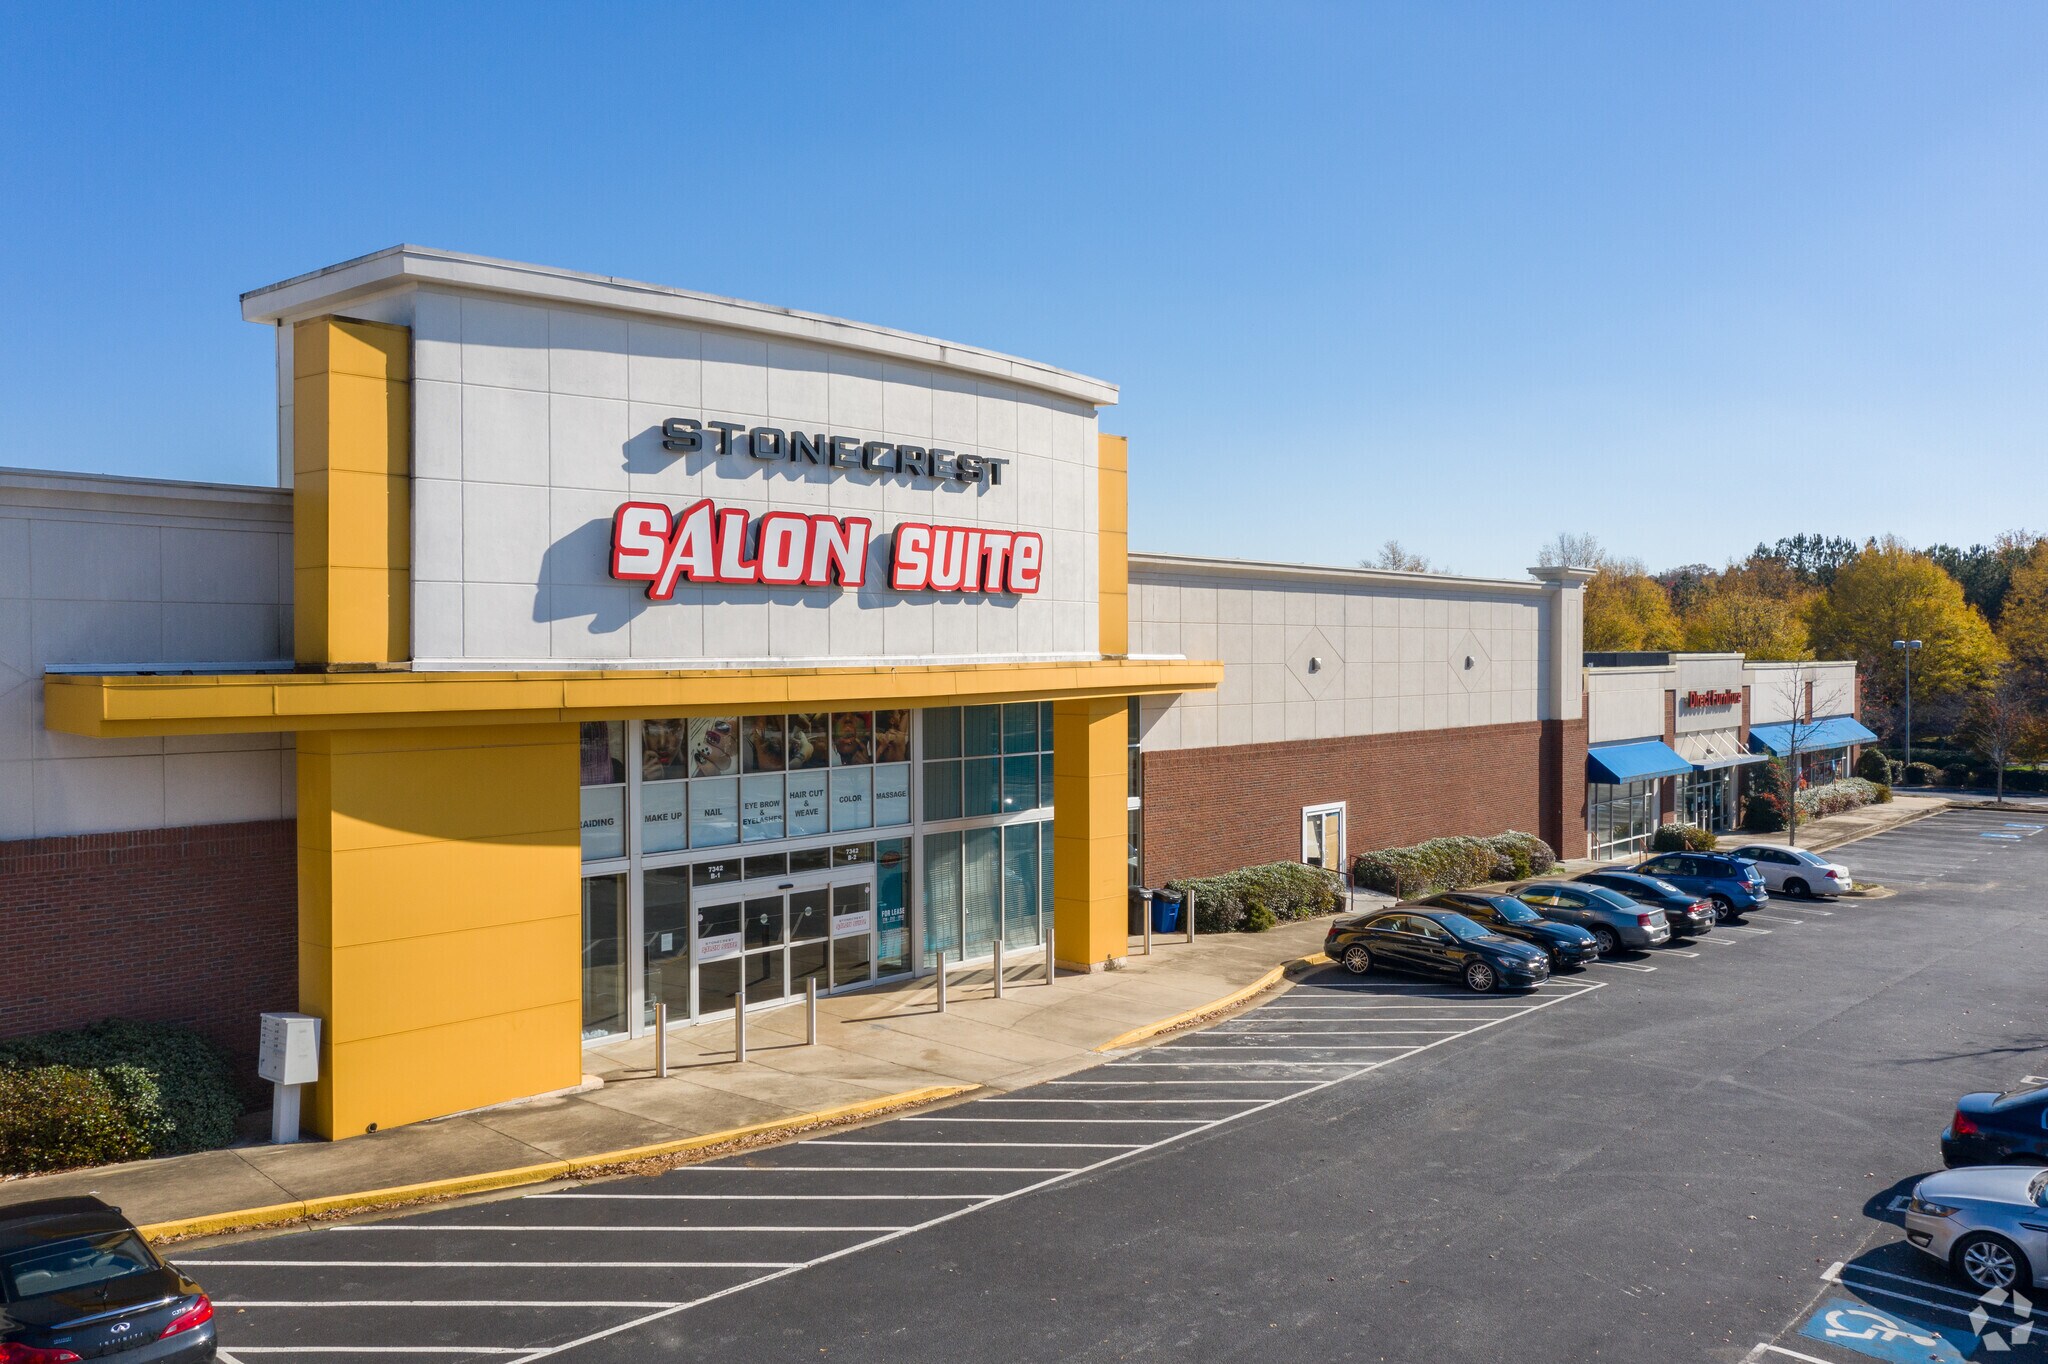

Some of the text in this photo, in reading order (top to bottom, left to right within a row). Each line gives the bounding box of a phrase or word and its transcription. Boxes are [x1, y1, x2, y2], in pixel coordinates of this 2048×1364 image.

[662, 417, 1010, 486] STONECREST
[609, 498, 872, 600] SALON
[1688, 690, 1713, 708] Direct
[808, 789, 824, 797] CUT
[876, 790, 907, 799] MASSAGE
[839, 794, 862, 803] COLOR
[759, 800, 780, 808] BROW
[644, 811, 682, 823] MAKE UP
[704, 808, 723, 817] NAIL
[795, 808, 819, 817] WEAVE
[708, 865, 724, 873] 7342
[881, 907, 905, 918] FOR LEASE
[99, 1332, 143, 1347] INFINITI
